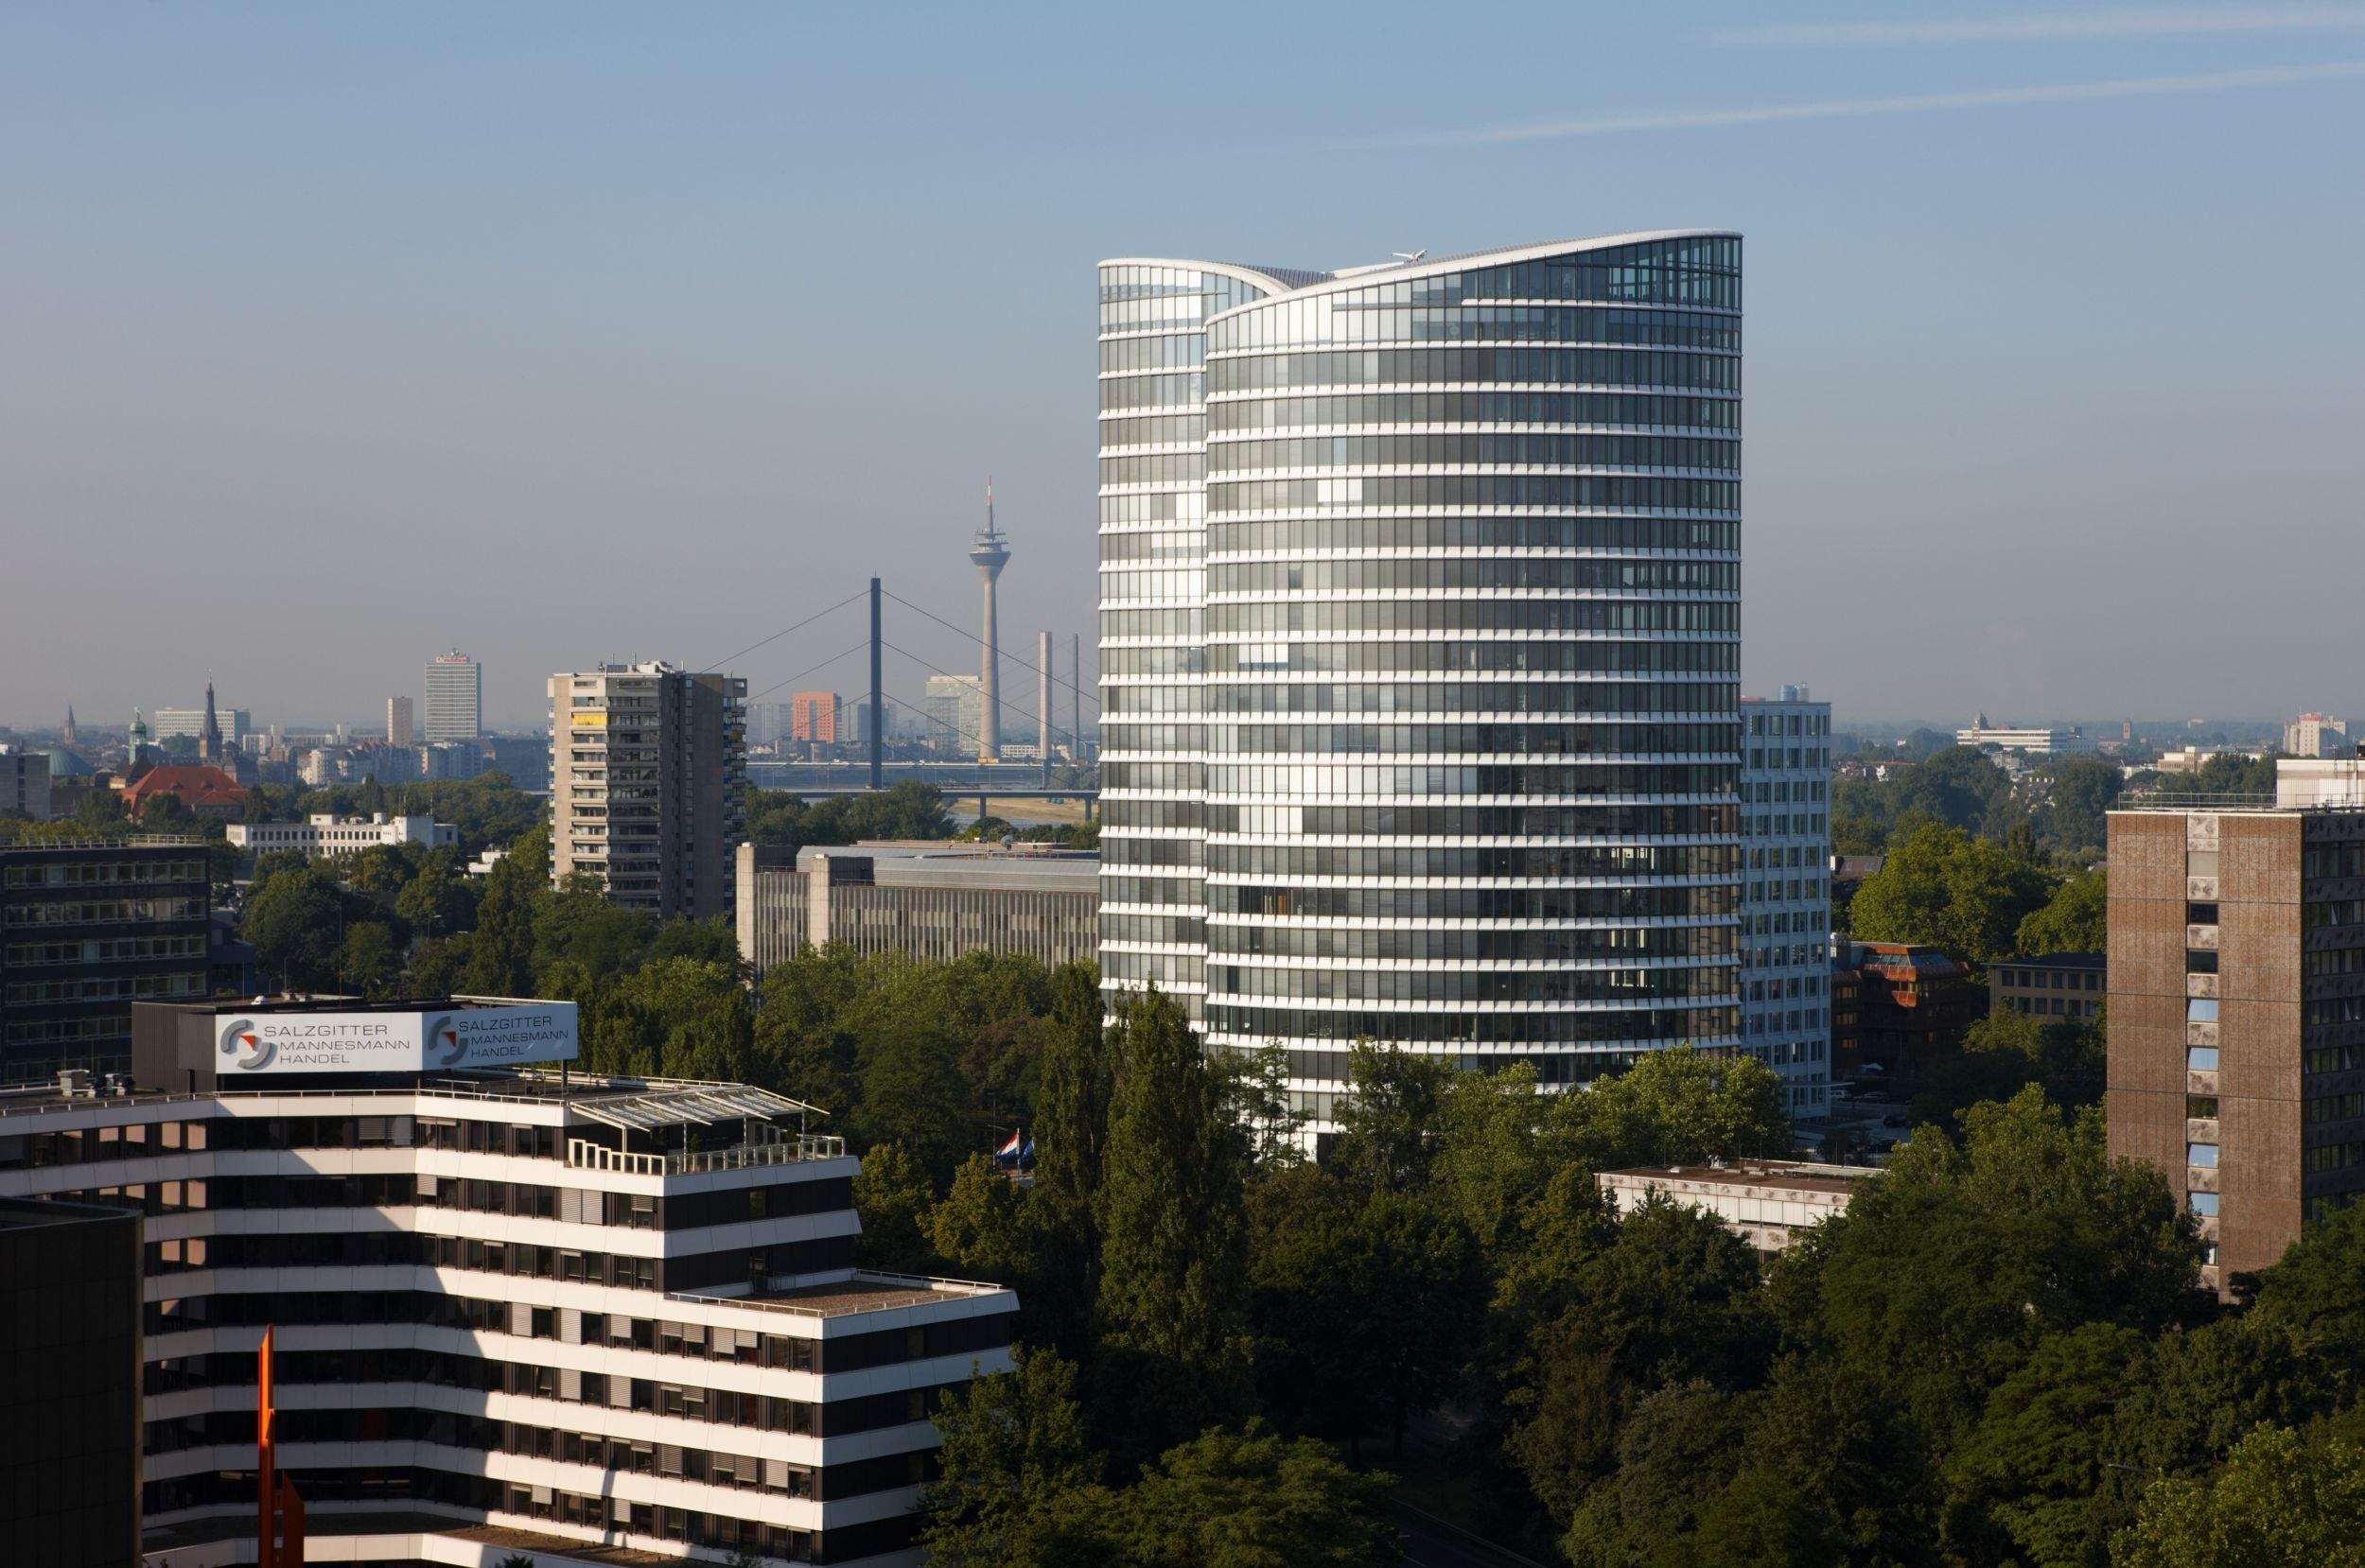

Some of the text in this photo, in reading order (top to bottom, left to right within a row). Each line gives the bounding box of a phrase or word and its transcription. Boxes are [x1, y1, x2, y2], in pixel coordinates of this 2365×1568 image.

[264, 1024, 388, 1037] SALZGITTER
[459, 1016, 552, 1033] SALZGITTER
[471, 1030, 568, 1045] MANNESMANN
[280, 1040, 411, 1051] MANNESMANN
[471, 1046, 524, 1058] HANDEL
[280, 1054, 350, 1064] HANDEL
